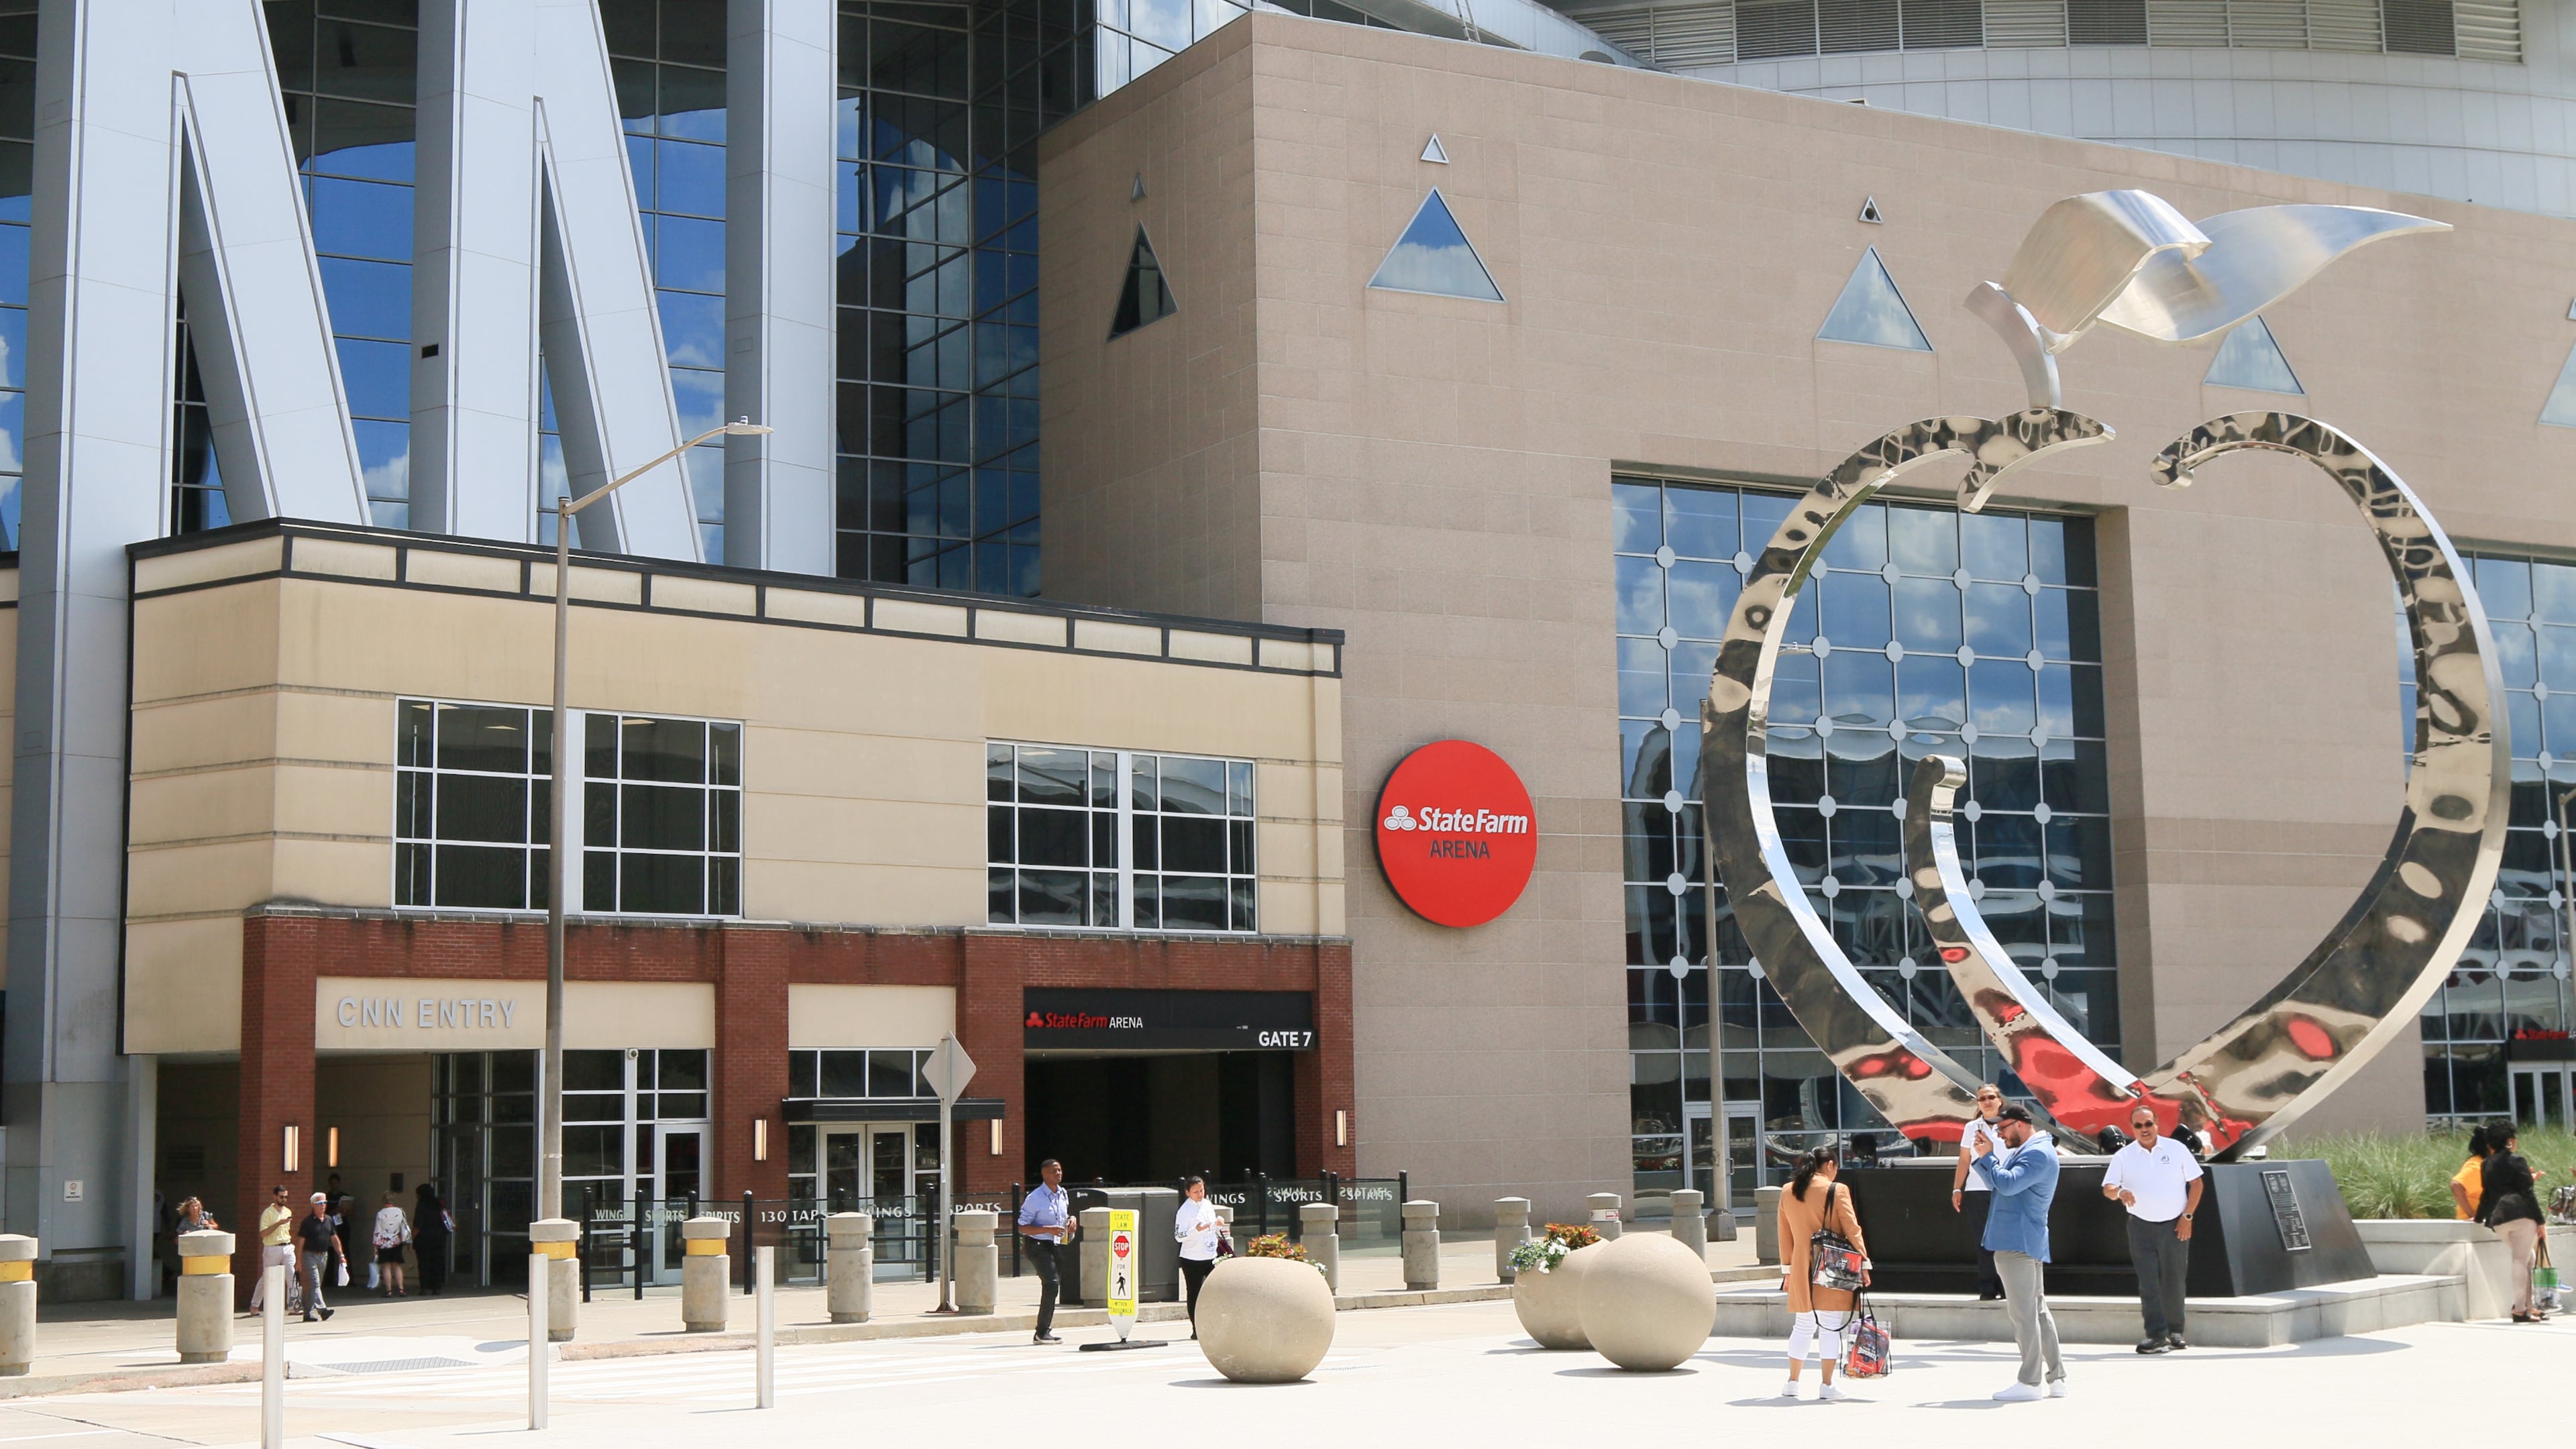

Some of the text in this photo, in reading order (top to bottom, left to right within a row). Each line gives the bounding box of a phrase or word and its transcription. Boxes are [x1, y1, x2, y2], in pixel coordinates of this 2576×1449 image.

[1430, 840, 1491, 859] ARENA
[337, 998, 516, 1028] CNN ENTRY
[1109, 1016, 1143, 1028] ARENA
[1258, 1031, 1312, 1046] GATE 7
[1274, 1191, 1322, 1202] SPORTS
[596, 1209, 628, 1220] WING
[645, 1210, 685, 1222] SRTS
[761, 1210, 787, 1222] 130
[861, 1206, 912, 1218] WINGS
[1114, 1242, 1129, 1251] STOP
